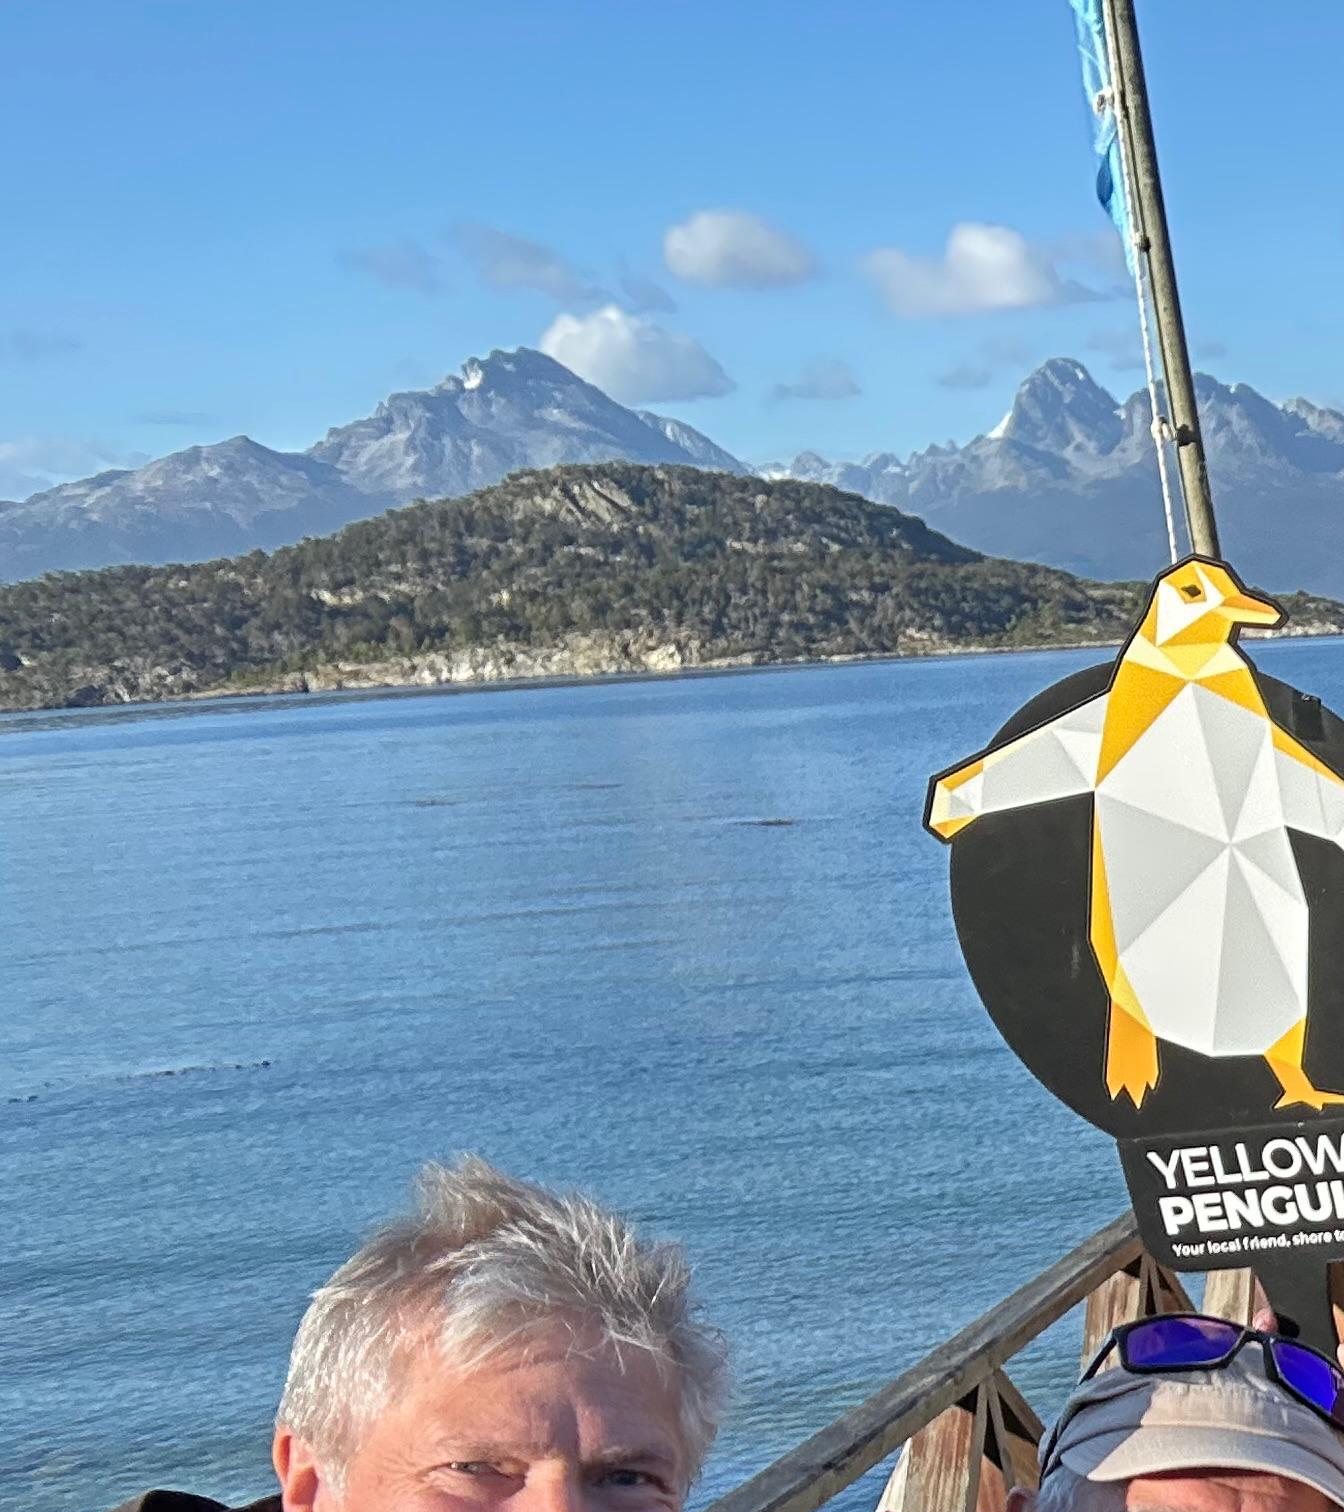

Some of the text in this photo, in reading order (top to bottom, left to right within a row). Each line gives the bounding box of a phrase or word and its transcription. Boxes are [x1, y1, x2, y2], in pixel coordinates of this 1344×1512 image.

[1171, 1243, 1205, 1258] Your
[1206, 1239, 1241, 1255] local
[1243, 1233, 1291, 1251] friend,
